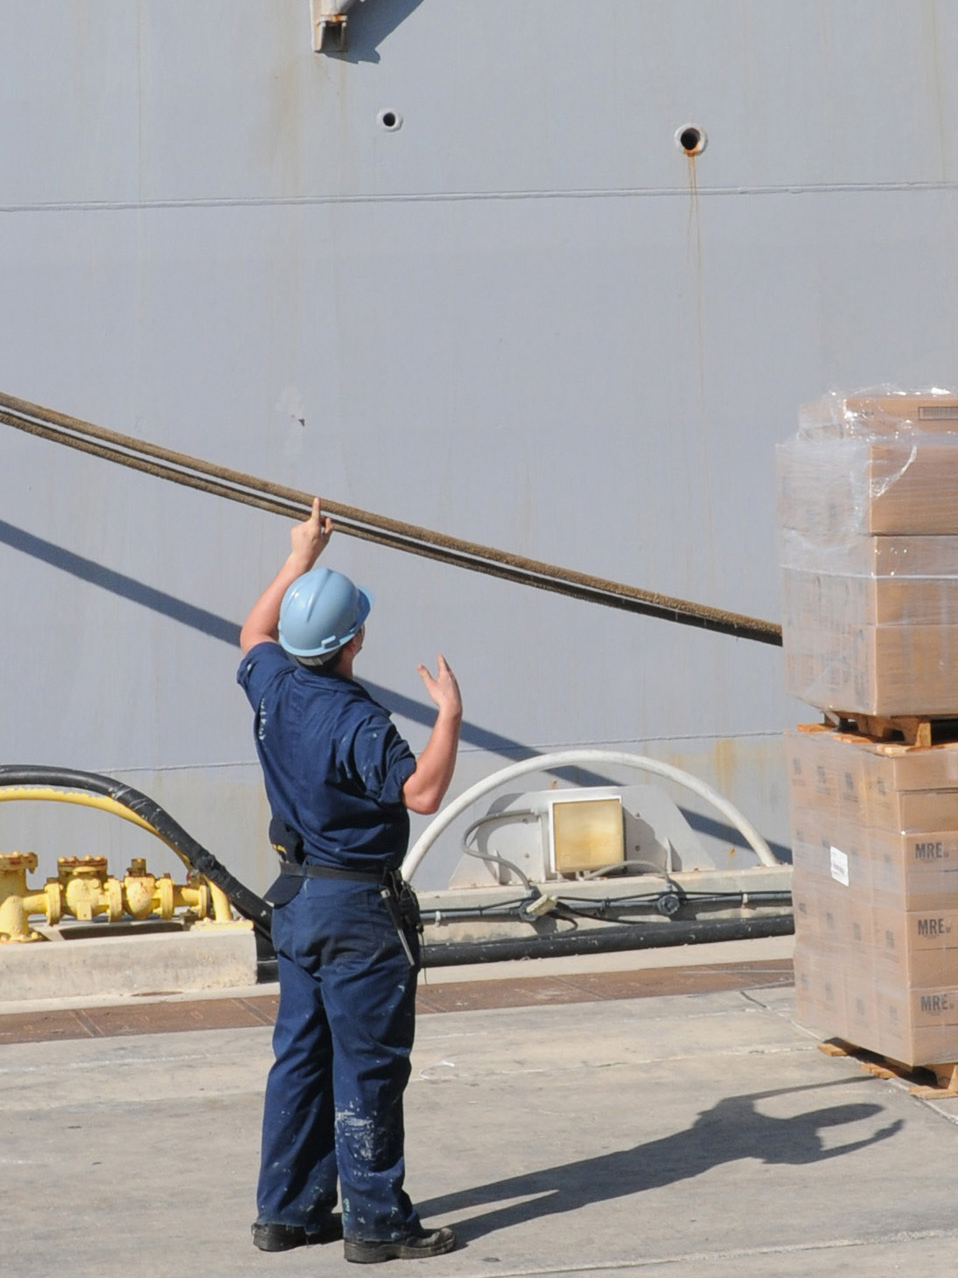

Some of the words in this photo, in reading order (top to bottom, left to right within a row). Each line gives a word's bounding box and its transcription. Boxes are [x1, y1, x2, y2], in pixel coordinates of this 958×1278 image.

[915, 842, 942, 859] MRE
[917, 918, 945, 935] MRE
[920, 994, 948, 1012] MRE
